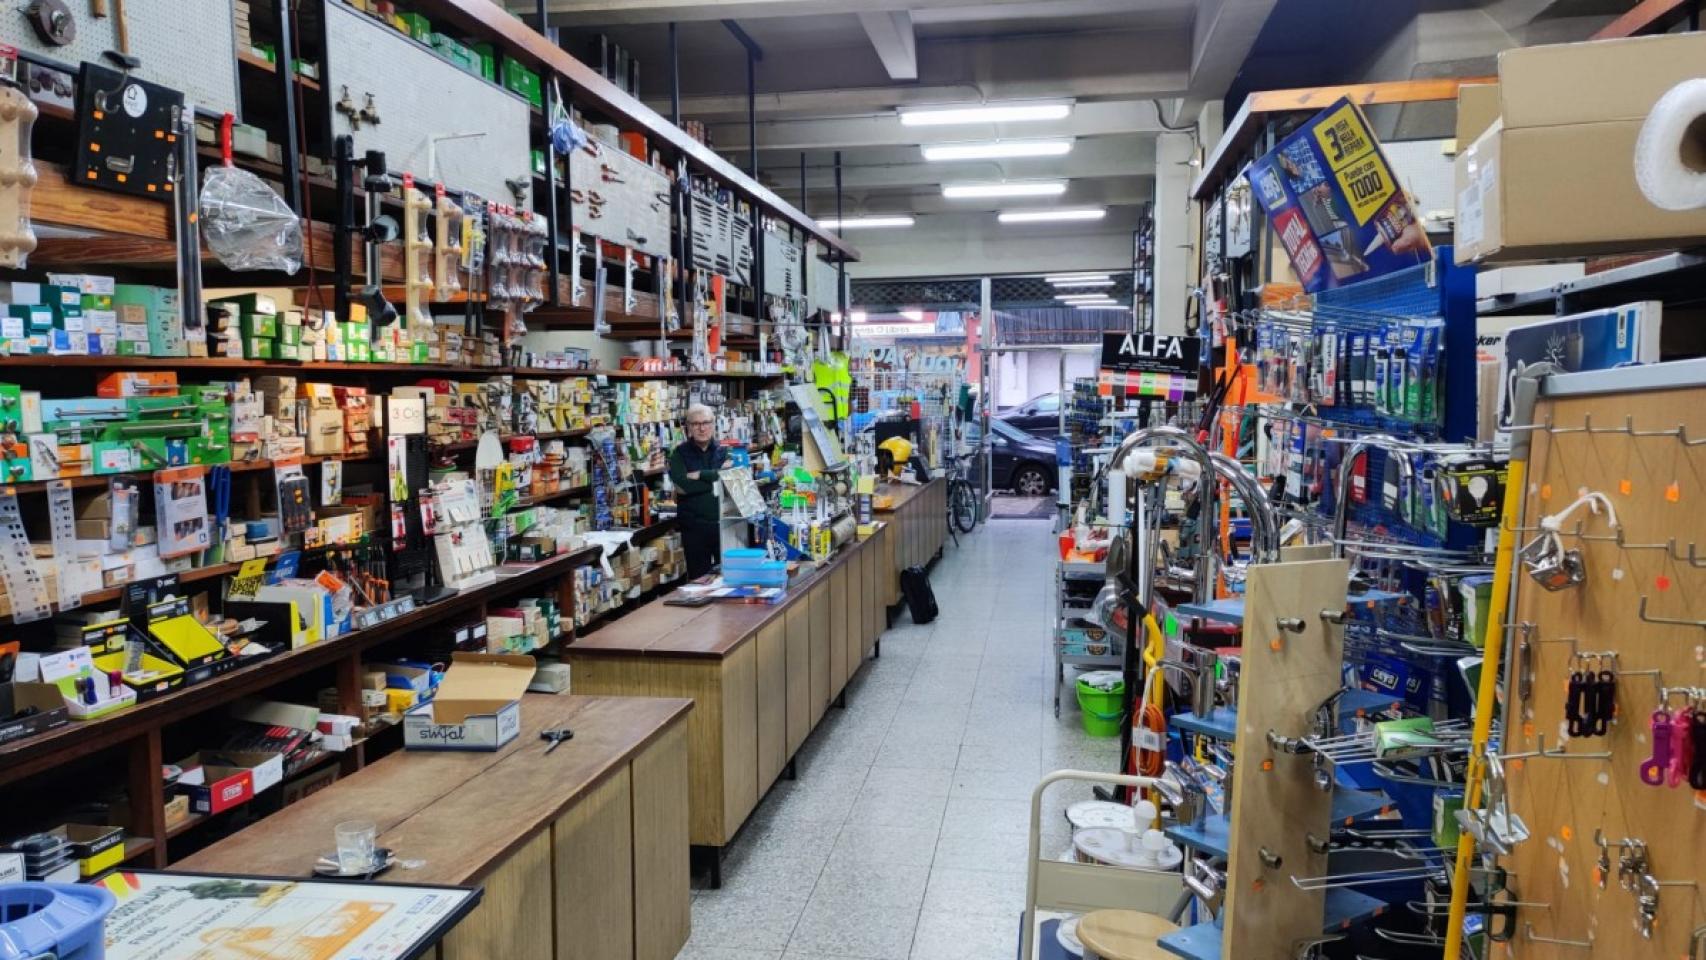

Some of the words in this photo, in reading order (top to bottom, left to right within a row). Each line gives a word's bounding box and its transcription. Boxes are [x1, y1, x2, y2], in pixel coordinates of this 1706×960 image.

[1323, 127, 1345, 162] 3
[1348, 170, 1384, 202] TODO
[1118, 332, 1184, 360] ALFA
